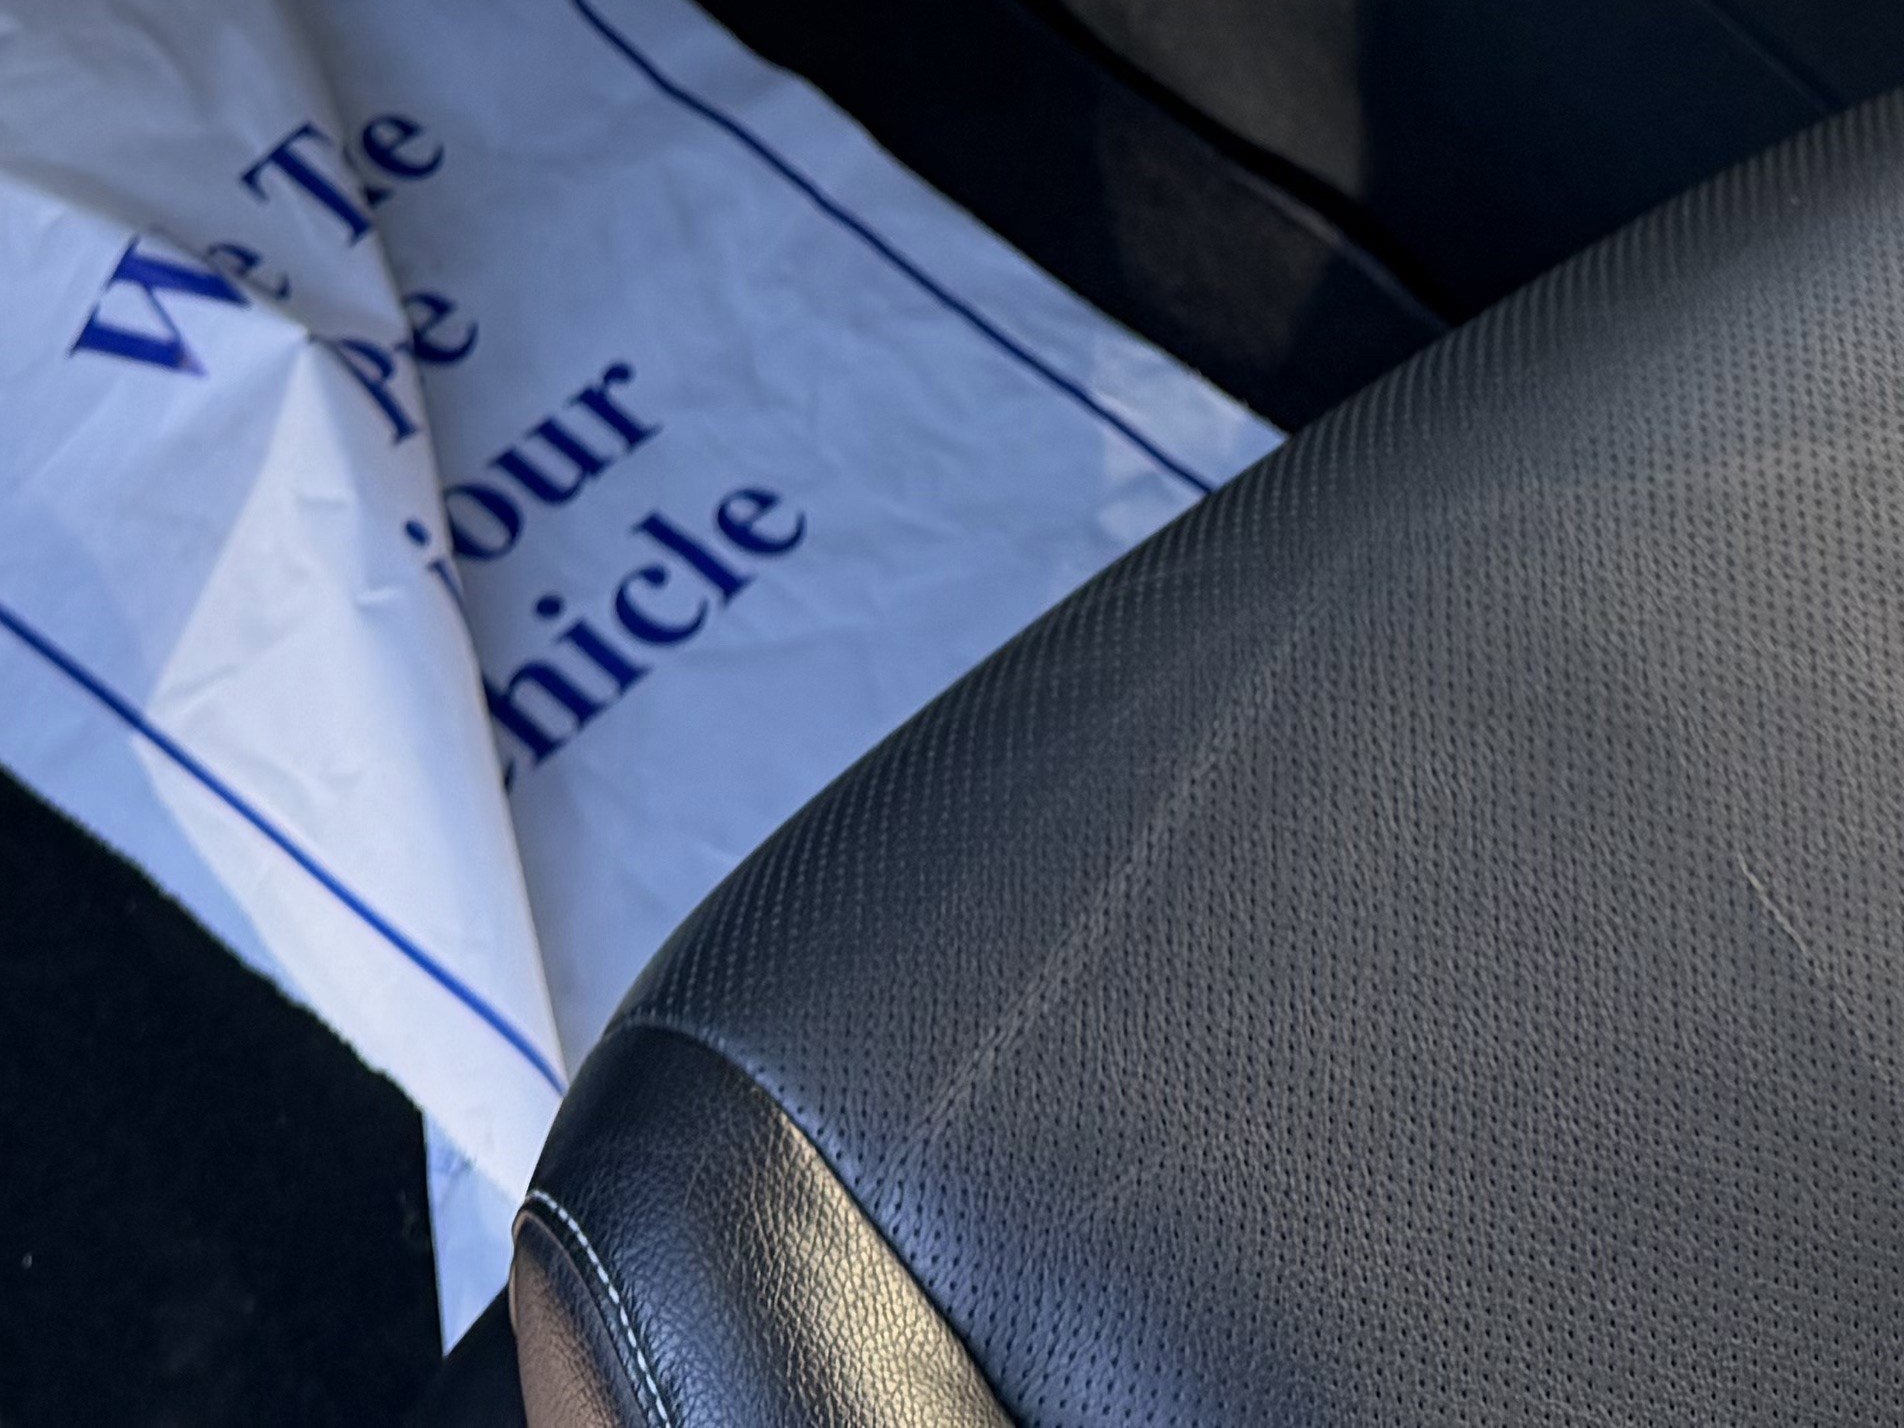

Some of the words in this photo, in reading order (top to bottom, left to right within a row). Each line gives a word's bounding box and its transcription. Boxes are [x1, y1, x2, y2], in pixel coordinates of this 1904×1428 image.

[64, 232, 291, 382] We
[233, 113, 447, 248] Te
[482, 485, 807, 792] hicle
